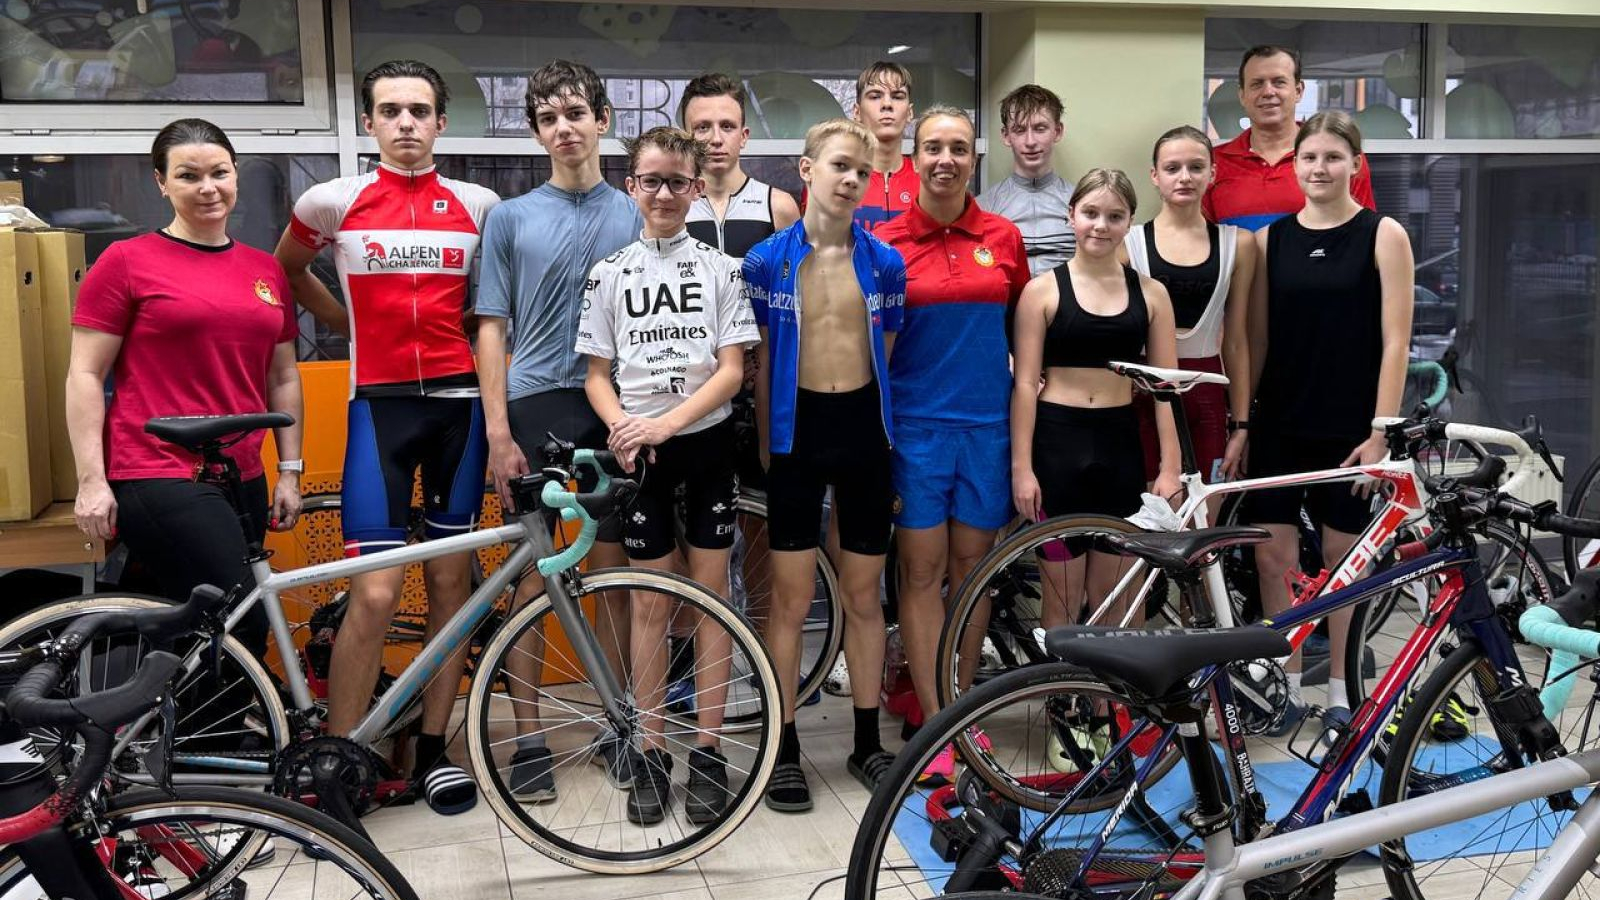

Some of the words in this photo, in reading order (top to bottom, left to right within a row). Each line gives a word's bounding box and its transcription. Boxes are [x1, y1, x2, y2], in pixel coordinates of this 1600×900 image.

[389, 246, 441, 259] ALPEN
[624, 282, 703, 318] UAE
[629, 324, 707, 346] Emirates
[1223, 703, 1240, 734] 4000
[1236, 752, 1256, 794] BAHRAIN
[1101, 781, 1138, 842] MERIDA
